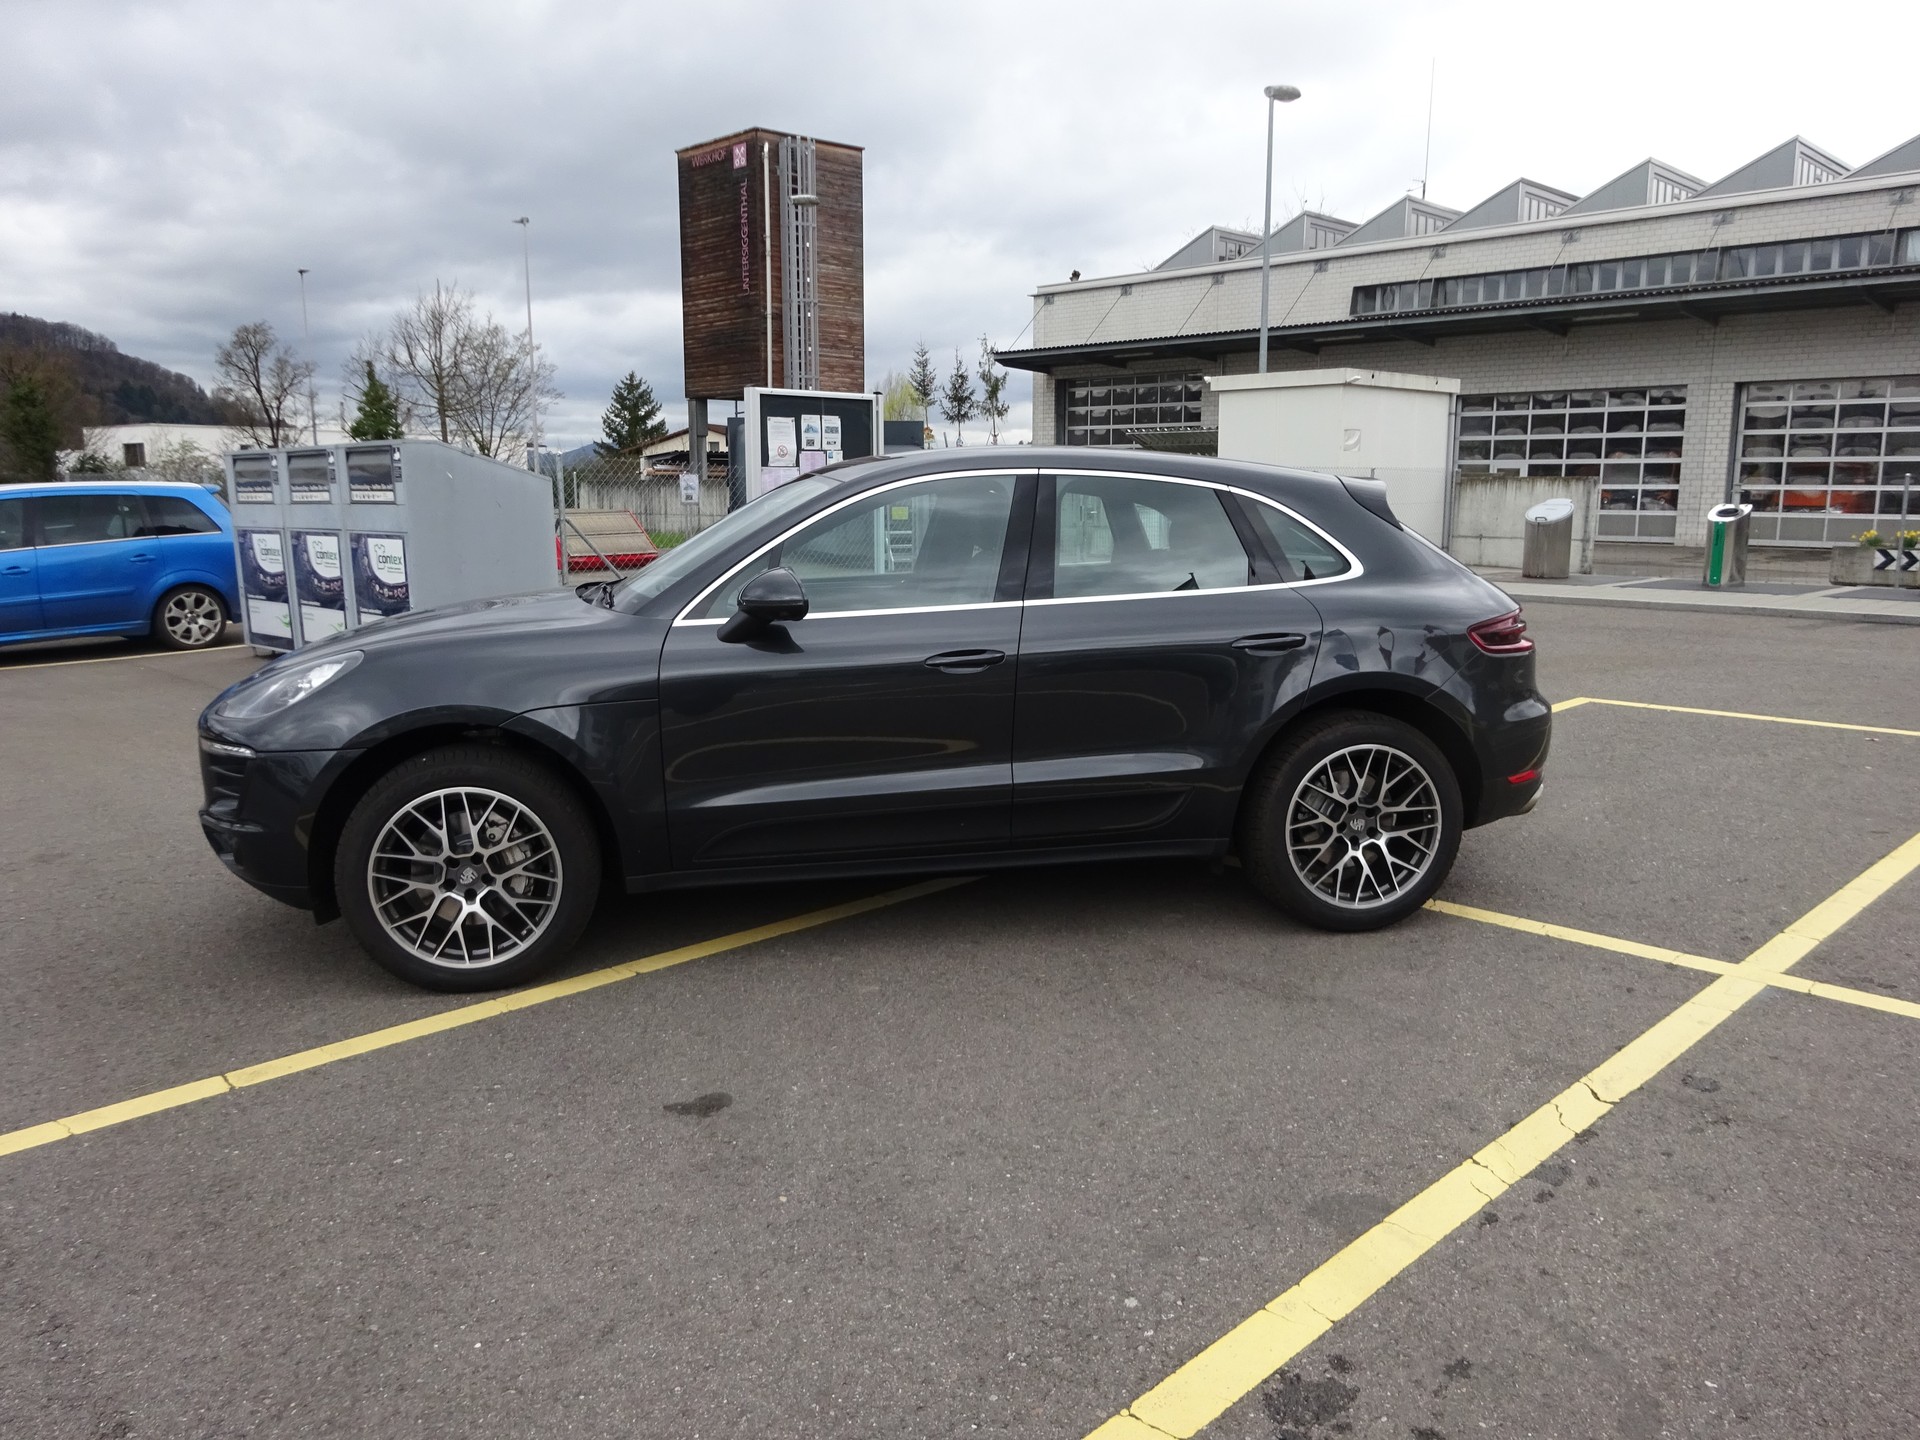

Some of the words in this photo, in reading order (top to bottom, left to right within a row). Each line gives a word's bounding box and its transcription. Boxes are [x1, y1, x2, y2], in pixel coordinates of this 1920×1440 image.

[692, 148, 727, 167] WERKHOF
[740, 178, 750, 296] UNTERSIGGENTHAL
[316, 550, 338, 560] contex
[378, 554, 403, 565] contex
